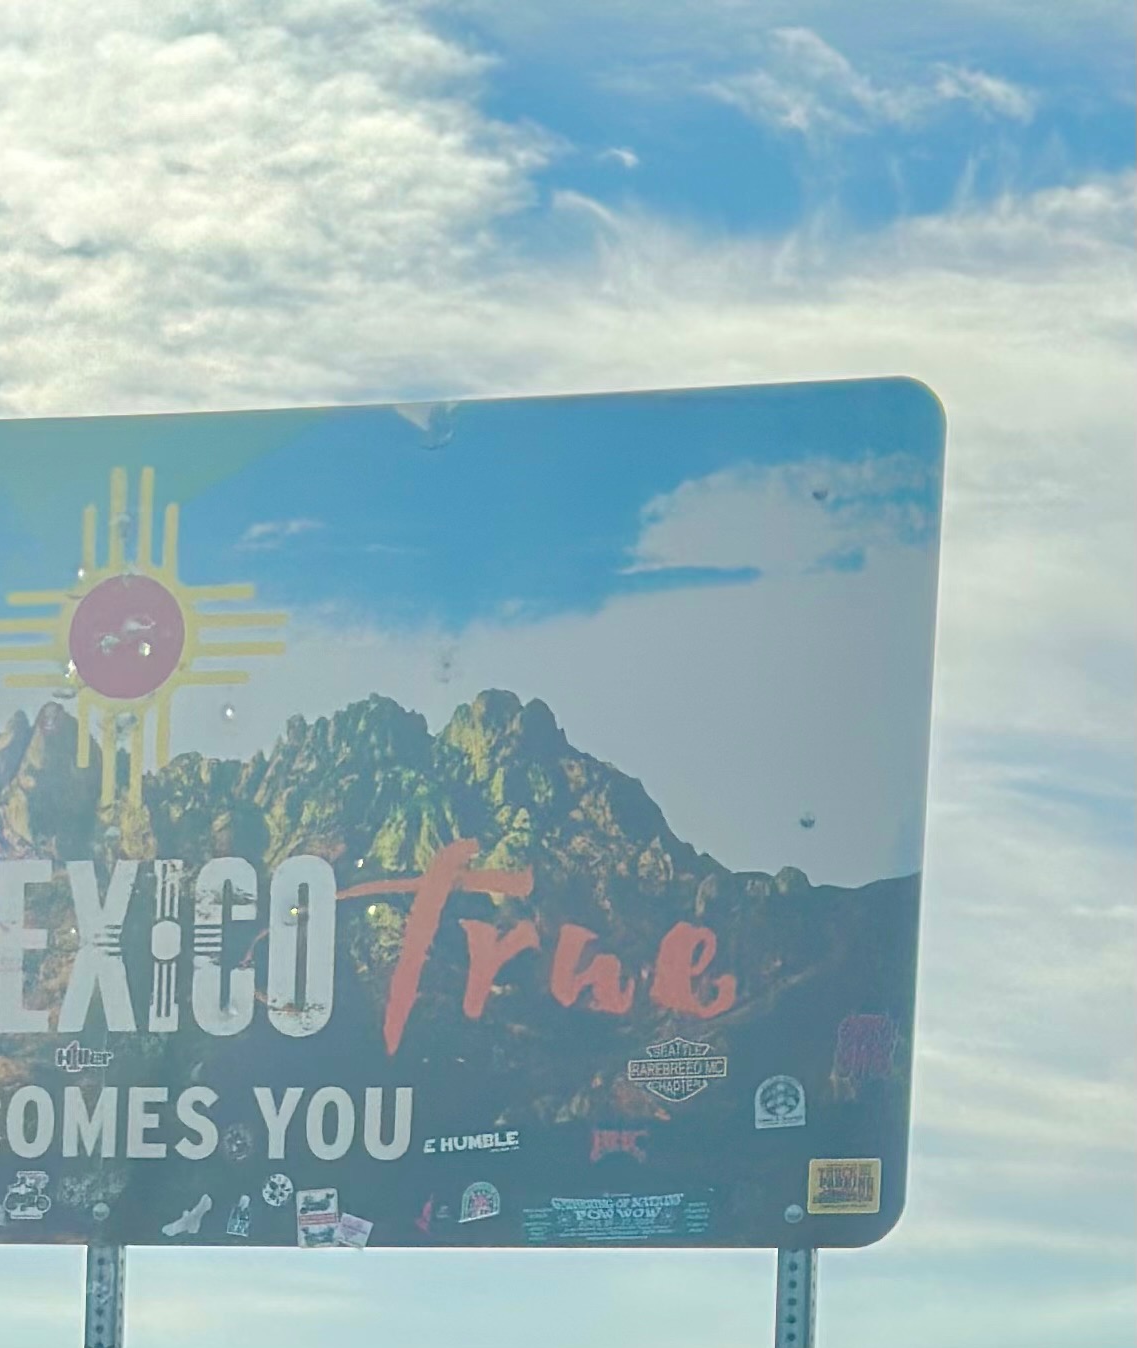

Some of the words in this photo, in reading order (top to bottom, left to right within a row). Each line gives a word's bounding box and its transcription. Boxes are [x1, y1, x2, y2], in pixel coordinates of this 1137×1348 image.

[336, 838, 737, 1056] True
[651, 1042, 703, 1058] SEATTLE
[705, 1059, 724, 1074] MC
[253, 1086, 414, 1160] YOU
[440, 1130, 519, 1152] HUMBLE
[574, 1208, 614, 1221] POW
[616, 1206, 663, 1219] WOW
